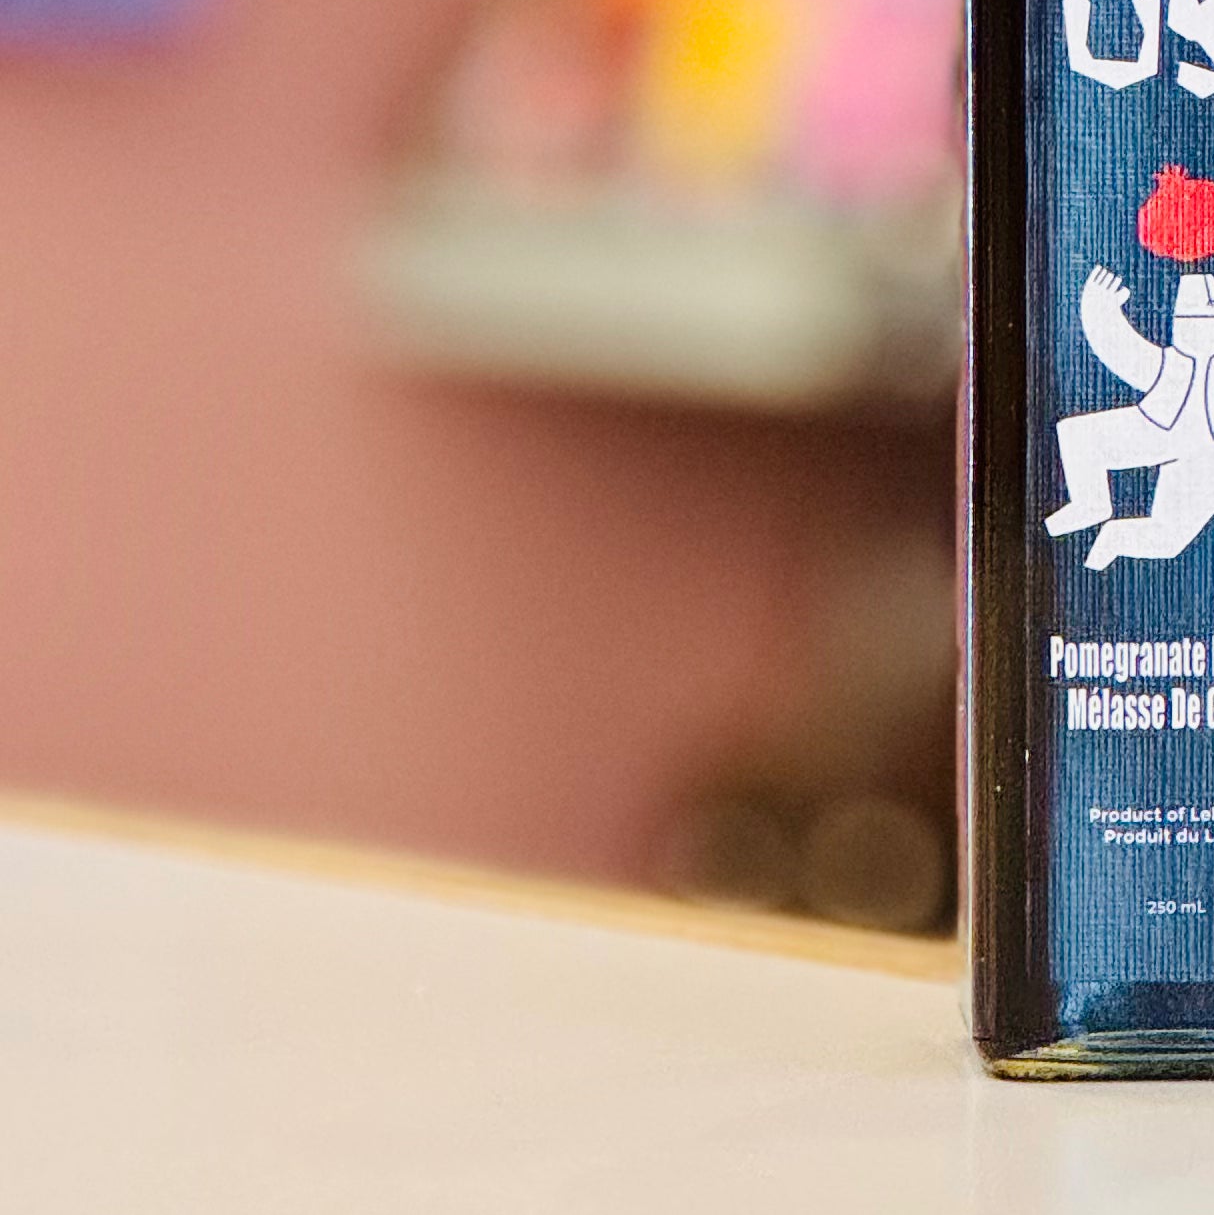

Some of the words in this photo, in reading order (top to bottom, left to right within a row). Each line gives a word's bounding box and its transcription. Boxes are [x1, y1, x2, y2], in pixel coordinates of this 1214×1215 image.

[1050, 635, 1206, 682] Pomegranate
[1067, 686, 1166, 730] Mélasse
[1171, 687, 1201, 729] De
[1089, 807, 1162, 823] Product
[1166, 806, 1186, 823] of
[1104, 828, 1171, 844] Produit
[1175, 828, 1200, 844] du
[1147, 900, 1176, 915] 250
[1180, 900, 1206, 914] mL
